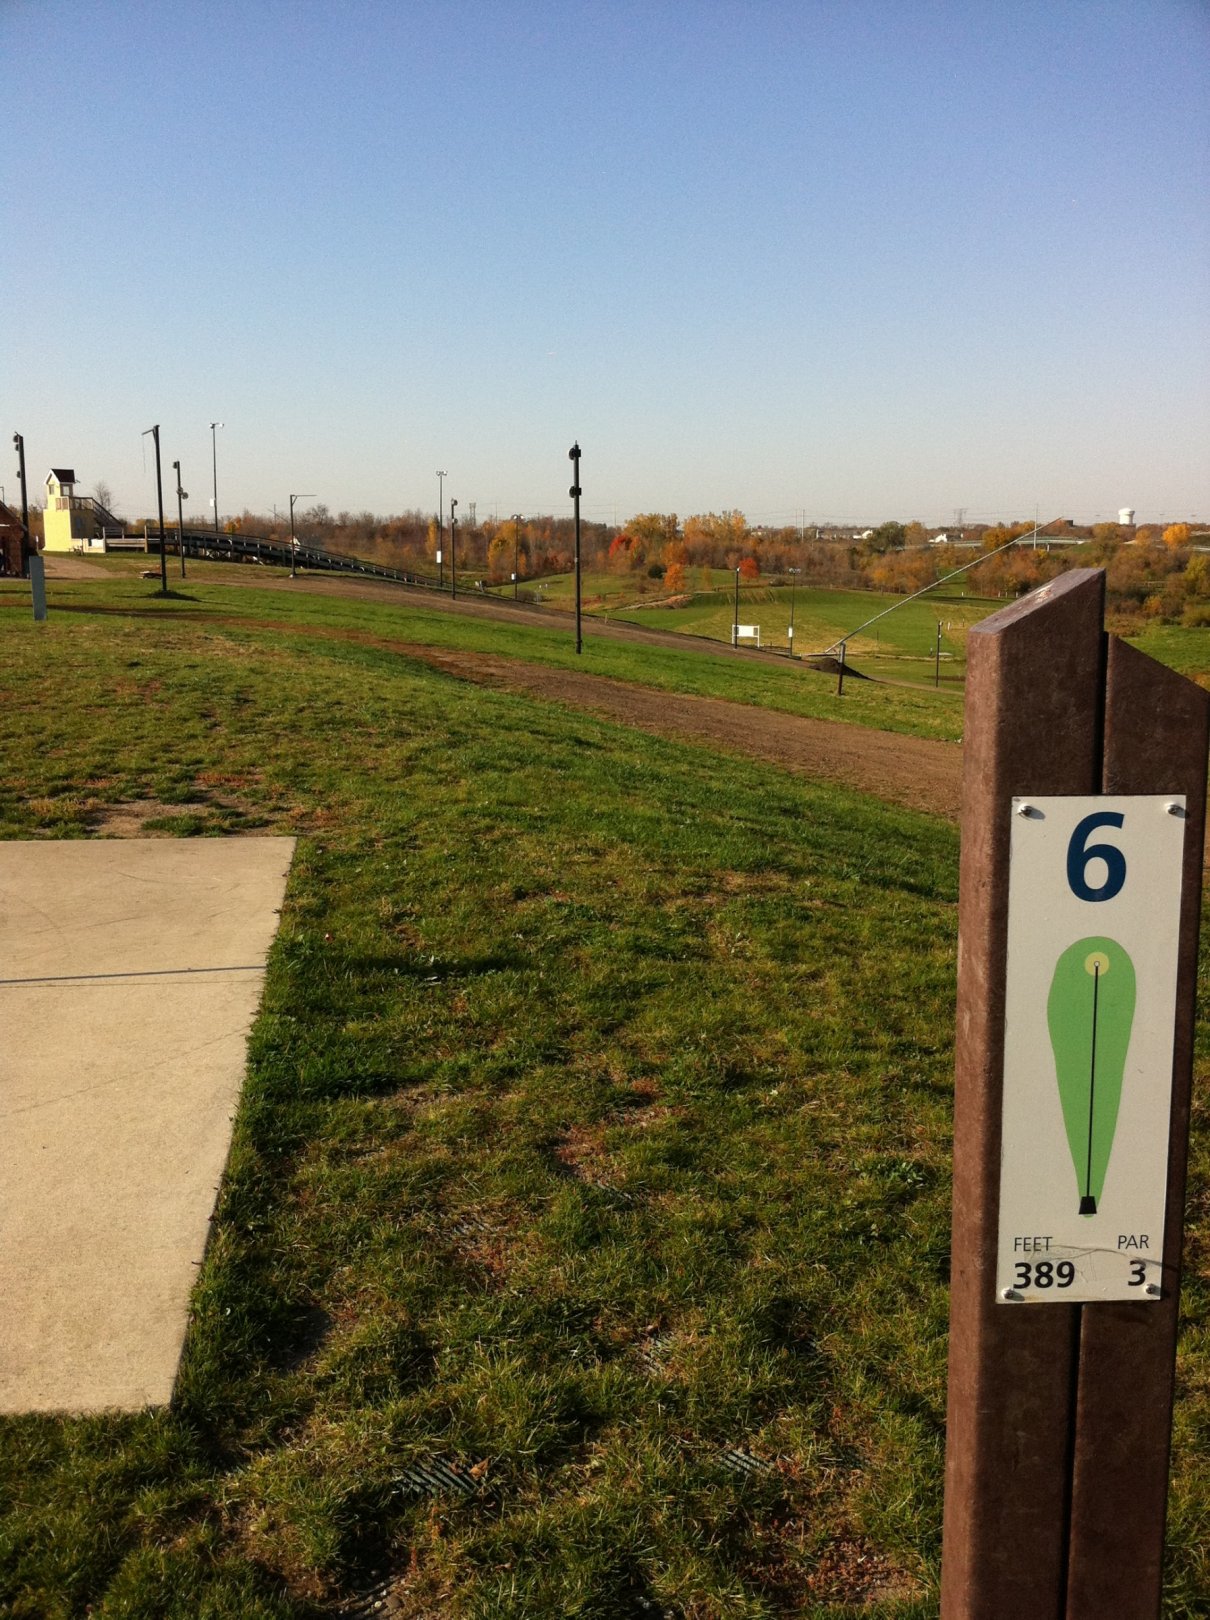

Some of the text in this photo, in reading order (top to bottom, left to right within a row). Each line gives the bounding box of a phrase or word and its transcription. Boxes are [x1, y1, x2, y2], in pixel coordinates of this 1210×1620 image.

[1066, 811, 1127, 903] 6
[1013, 1236, 1053, 1252] FEET
[1117, 1234, 1150, 1250] PAR
[1012, 1261, 1076, 1289] 389
[1127, 1259, 1147, 1287] 3
